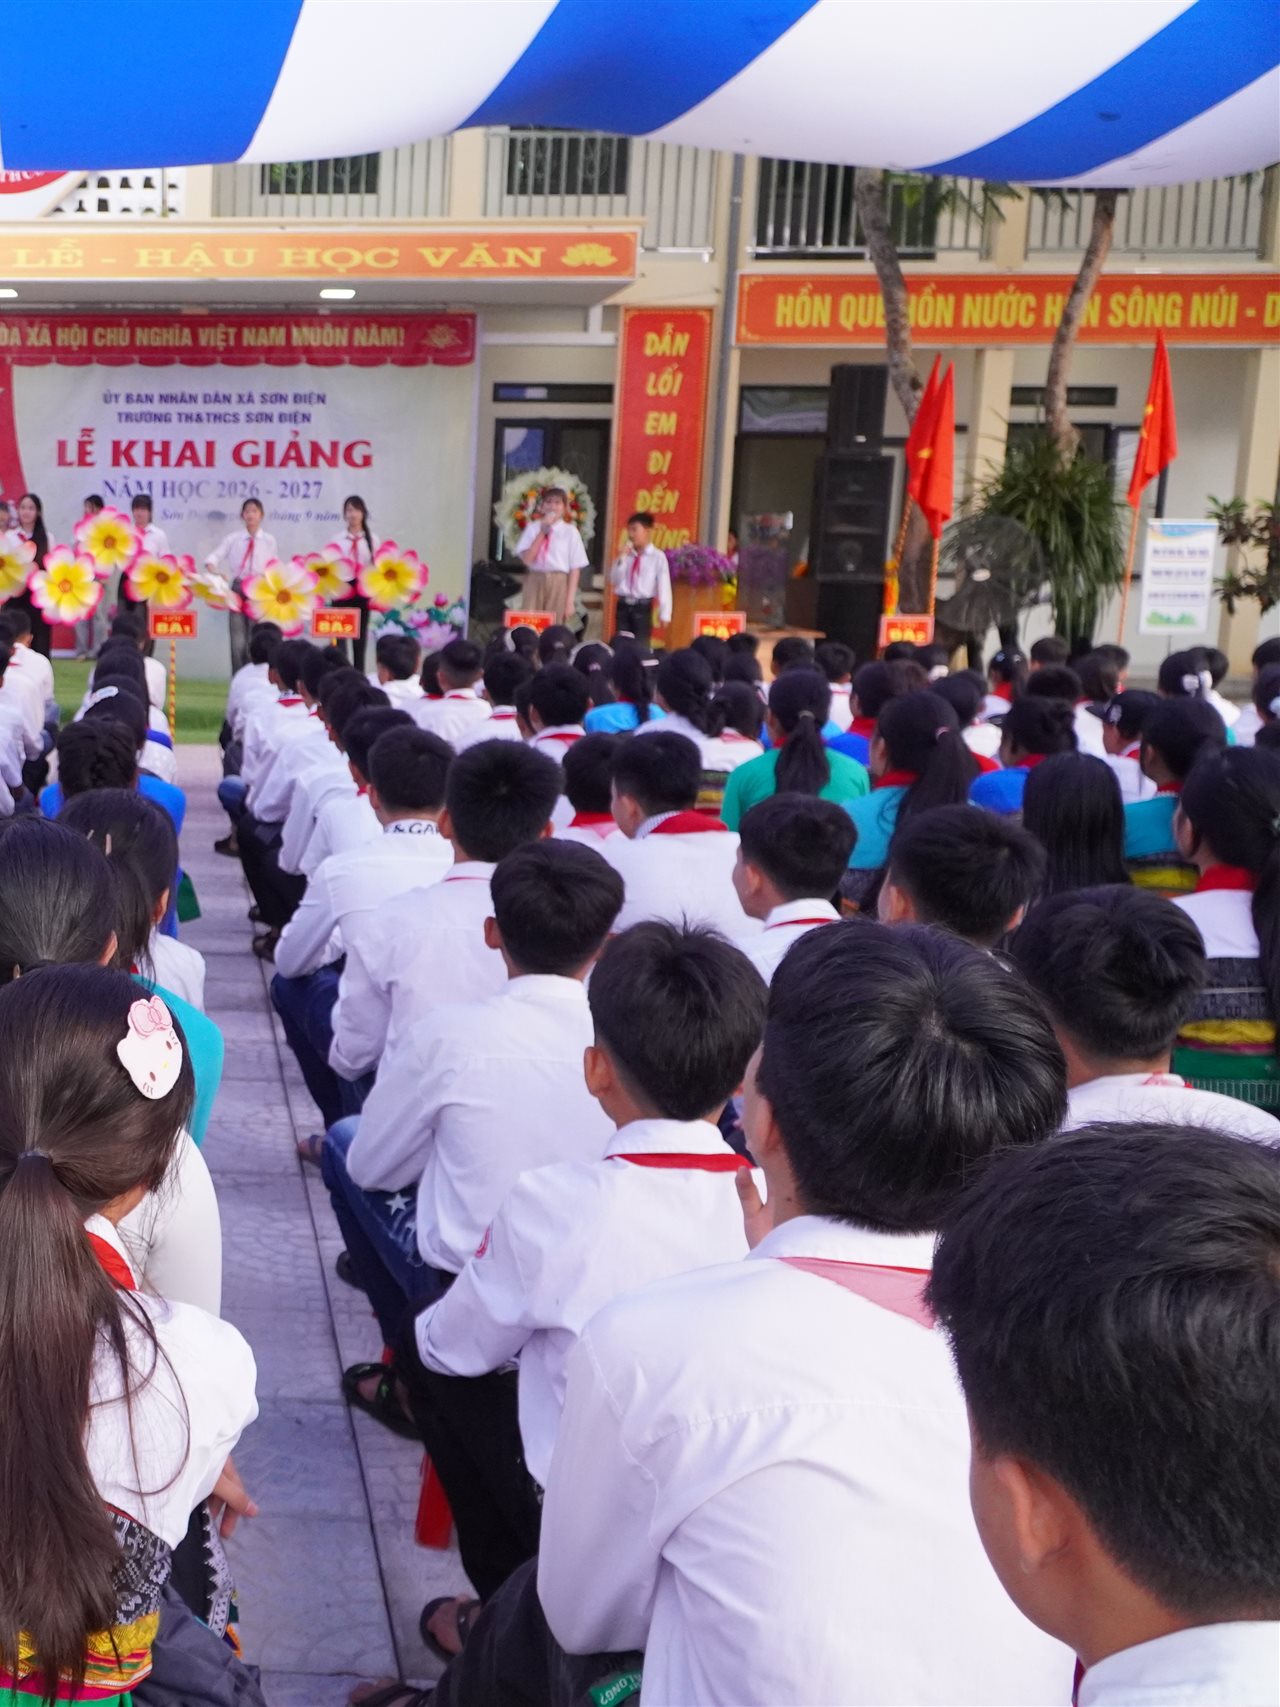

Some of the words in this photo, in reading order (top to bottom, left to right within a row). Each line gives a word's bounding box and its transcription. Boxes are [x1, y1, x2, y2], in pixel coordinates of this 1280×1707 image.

[12, 236, 84, 268] LỄ
[134, 242, 258, 272] HẬU
[278, 247, 400, 272] HỌC
[417, 241, 544, 268] VĂN
[775, 282, 832, 328] HỒN
[962, 282, 1036, 328] NƯỚC
[1043, 292, 1102, 328] HN
[1107, 284, 1184, 328] SÔNG
[1190, 284, 1239, 328] NÚI
[26, 322, 53, 347] XÃ
[56, 322, 88, 351] HỘI
[92, 318, 131, 347] CHỦ
[135, 322, 193, 347] NGHĨA
[197, 322, 237, 351] VIỆT
[242, 326, 287, 347] NAM
[291, 323, 349, 347] MUÔN
[353, 323, 405, 347] NĂM!
[644, 322, 691, 357] DẪN
[646, 362, 684, 397] LỐI
[125, 392, 154, 404] BAN
[158, 390, 199, 404] NHÂN
[203, 390, 232, 404] DÂN
[260, 391, 288, 404] SƠN
[292, 390, 327, 407] ĐIỆN
[117, 410, 172, 424] TRƯỜNG
[176, 411, 241, 424] TH&THCS
[245, 411, 274, 424] SƠN
[278, 410, 312, 426] ĐIỆN
[644, 410, 678, 436] EM
[57, 428, 96, 468] LỄ
[111, 440, 216, 468] KHAI
[232, 430, 374, 468] GIẢNG
[102, 475, 154, 499] NĂM
[161, 480, 210, 503] HỌC
[219, 480, 261, 499] 2026
[279, 480, 324, 499] 2027
[635, 480, 681, 514] ĐẾN
